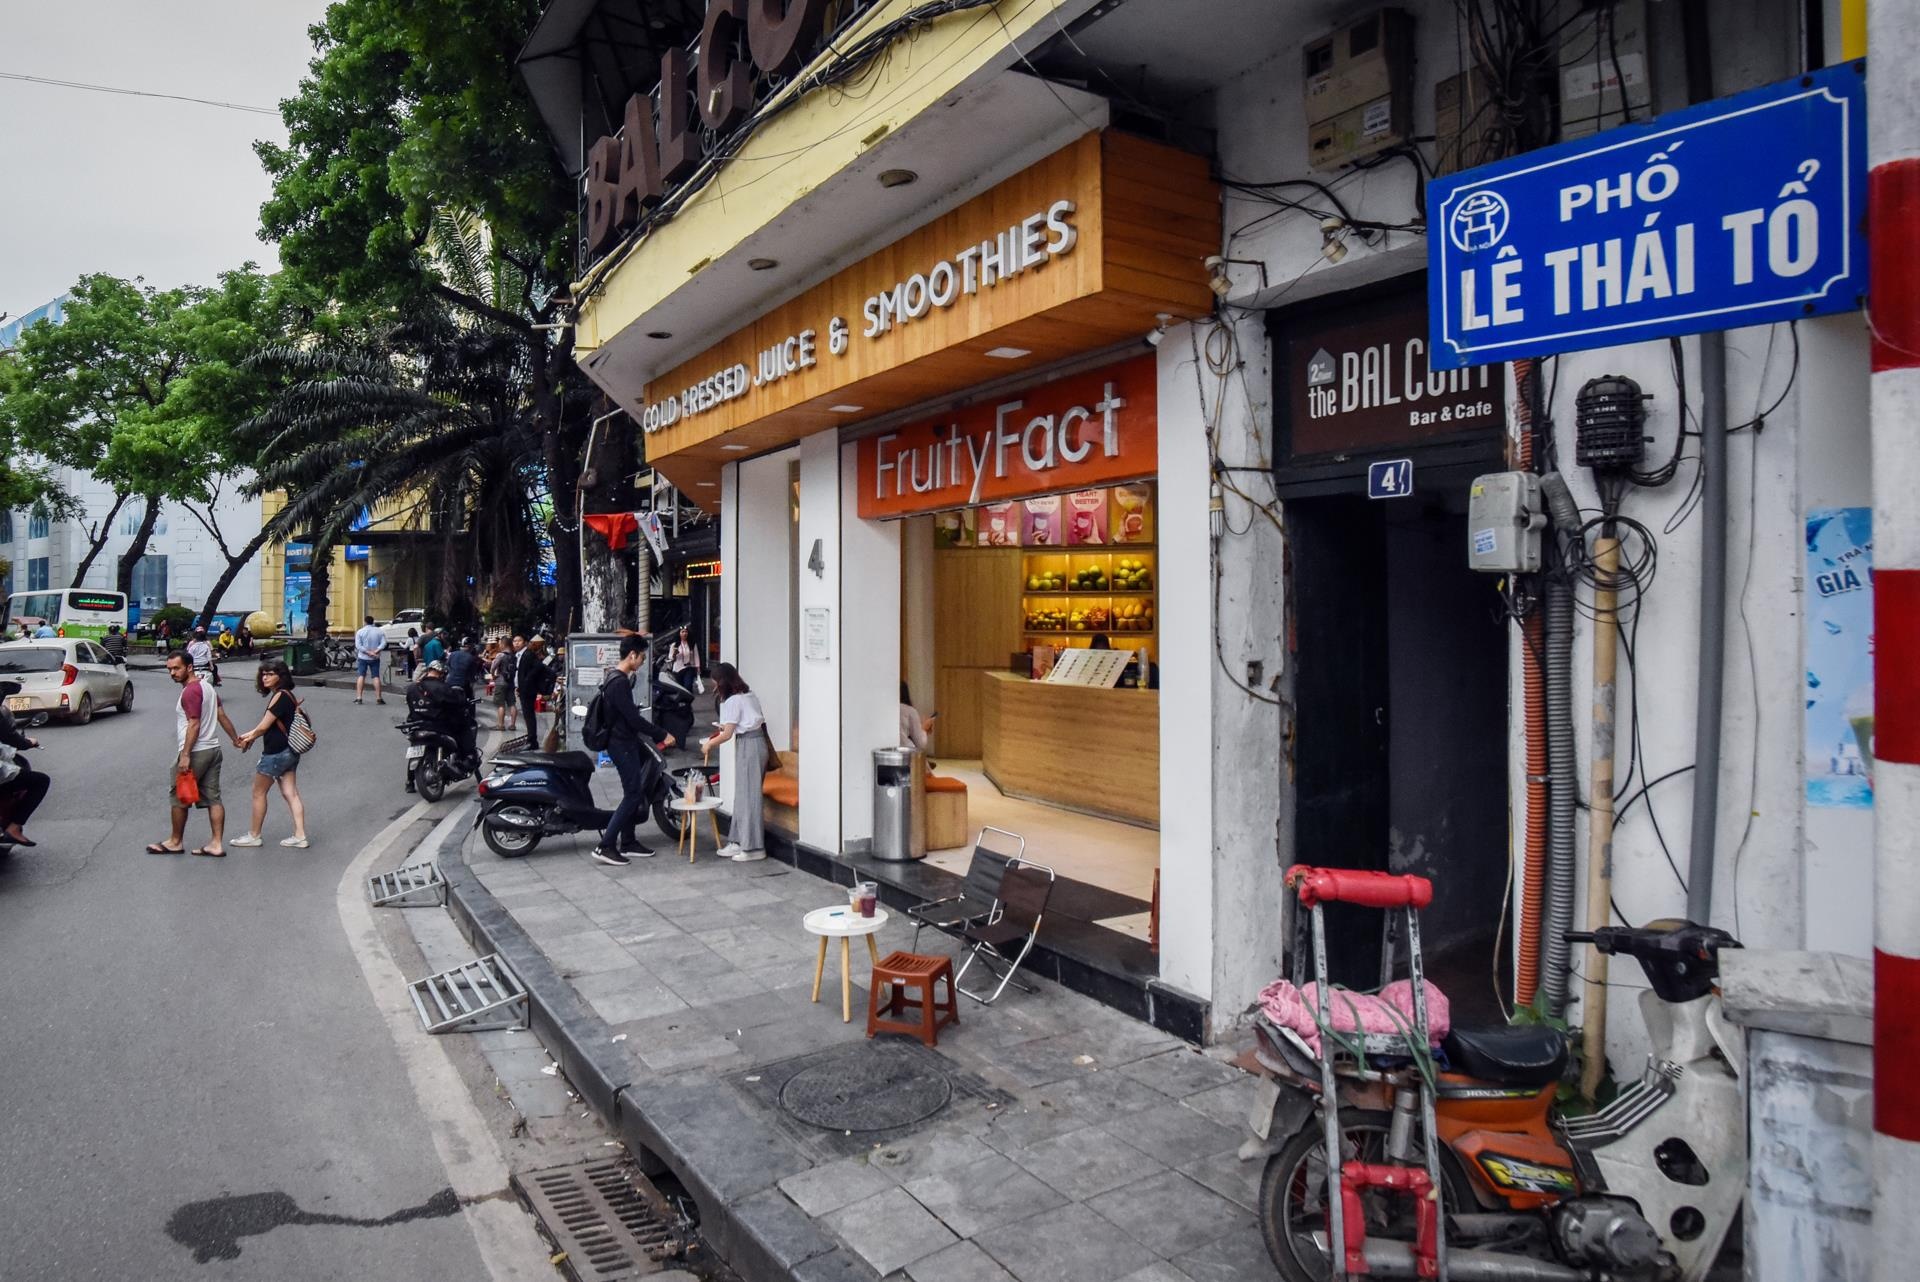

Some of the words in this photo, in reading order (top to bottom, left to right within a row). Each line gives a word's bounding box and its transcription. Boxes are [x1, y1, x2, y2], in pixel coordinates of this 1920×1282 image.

[1560, 140, 1684, 222] PHỐ
[1461, 245, 1524, 331] LÊ
[1544, 211, 1695, 316] THÁI
[1721, 158, 1820, 286] TỔ
[643, 396, 682, 433] COLD
[682, 363, 749, 418] PRESSED
[753, 329, 817, 387] JUICE
[829, 316, 849, 356] &
[863, 200, 1077, 337] SMOOTHIES
[876, 382, 1126, 504] FruityFact
[1308, 385, 1337, 419] the
[1410, 411, 1437, 426] Bar
[1440, 406, 1452, 422] &
[1455, 401, 1492, 420] Cafe
[807, 538, 825, 579] 4
